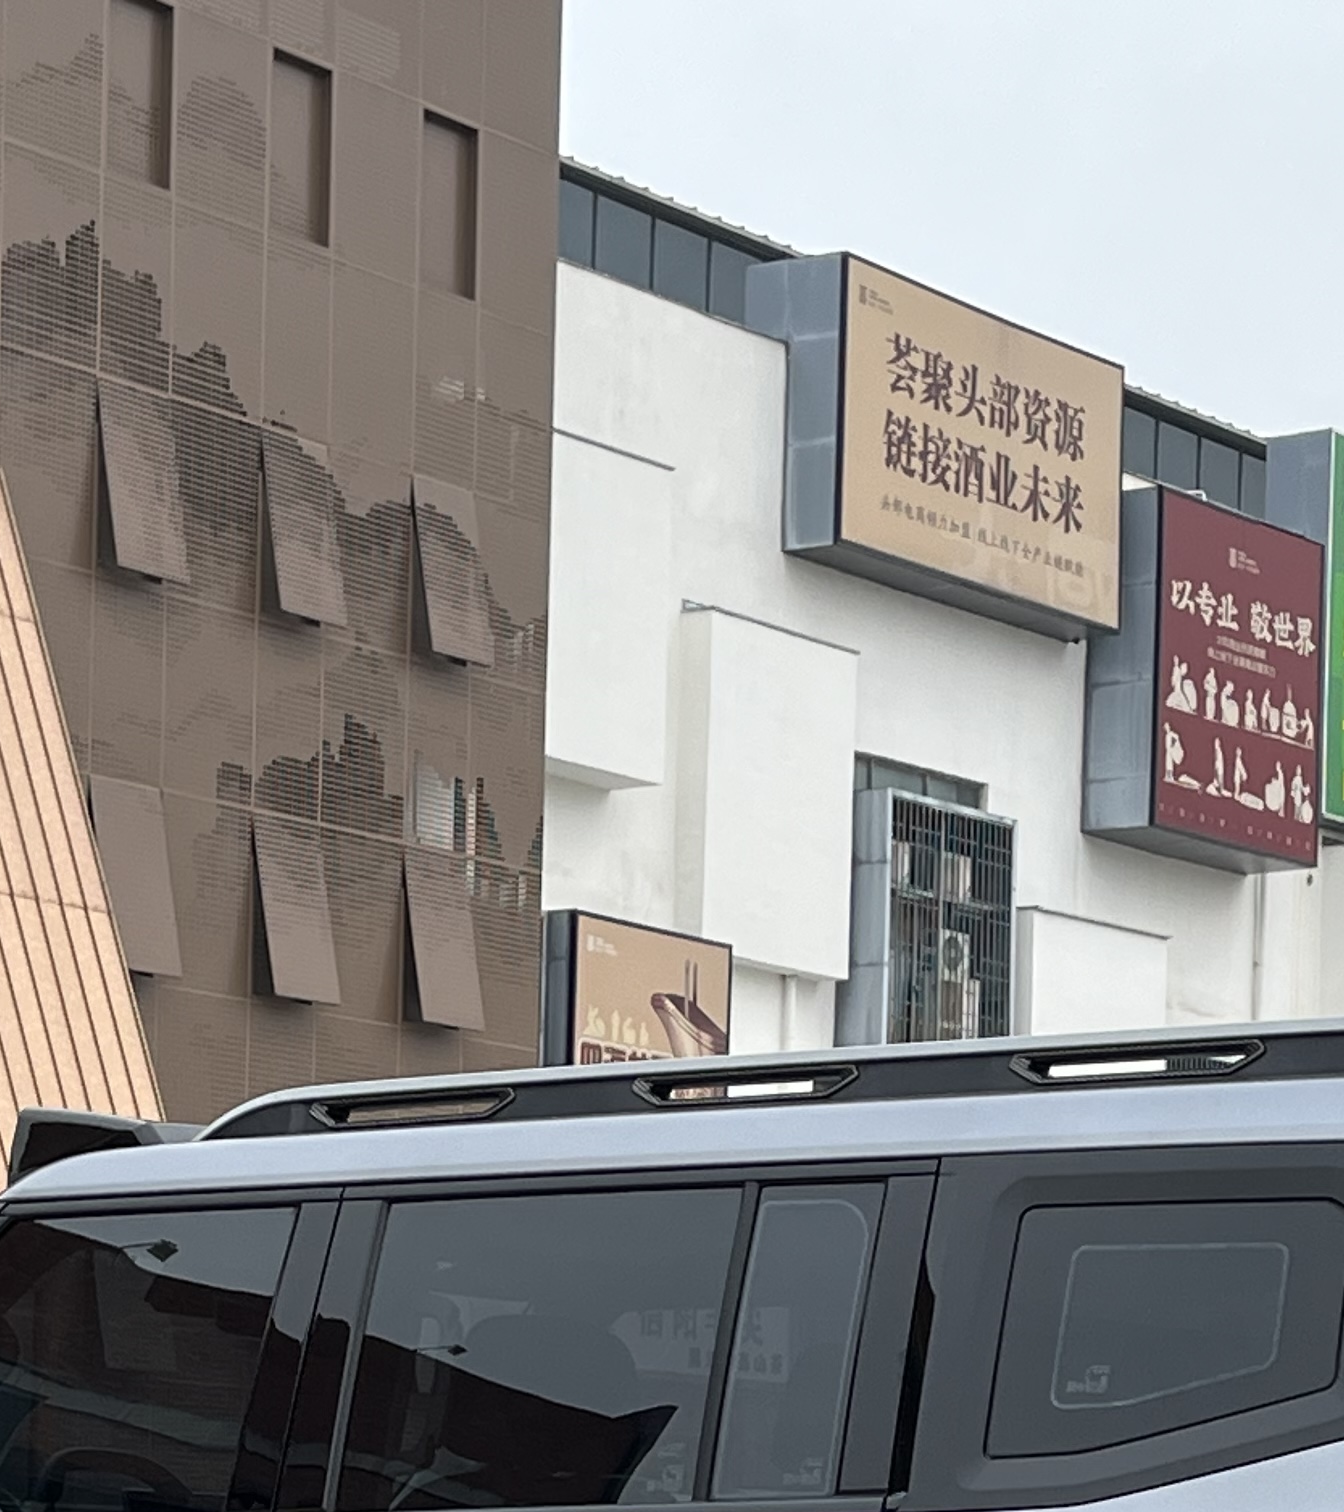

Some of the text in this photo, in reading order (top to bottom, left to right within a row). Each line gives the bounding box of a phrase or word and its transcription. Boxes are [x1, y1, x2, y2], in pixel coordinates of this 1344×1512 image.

[885, 331, 1086, 463] 荟聚头部资源
[882, 409, 1085, 536] 链接酒业未来
[1170, 579, 1240, 632] 以专业
[1249, 600, 1317, 658] 敬世界
